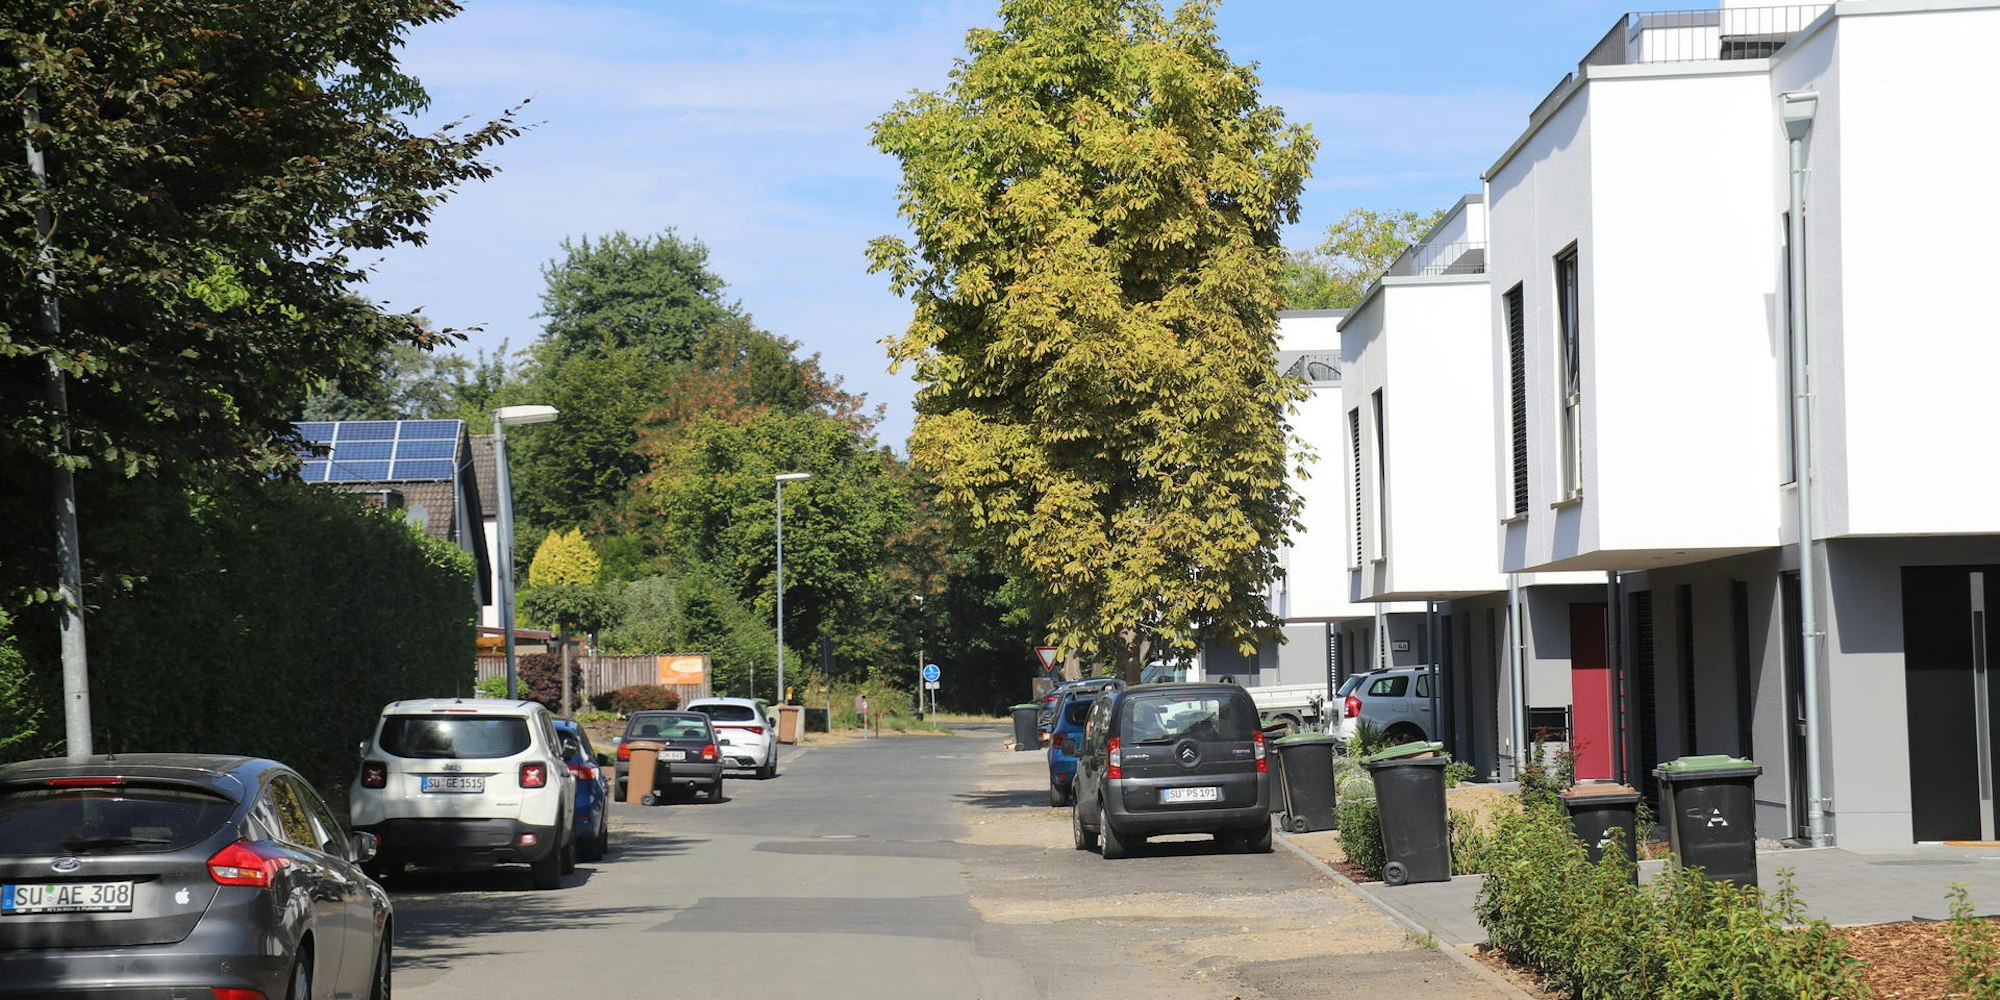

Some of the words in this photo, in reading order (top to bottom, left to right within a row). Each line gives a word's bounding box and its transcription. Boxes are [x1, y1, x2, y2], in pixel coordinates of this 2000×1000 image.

[428, 778, 440, 788] SU
[446, 778, 458, 788] GE
[461, 778, 482, 788] 1515
[1170, 790, 1182, 799] SU
[1186, 789, 1198, 798] PS
[1200, 788, 1216, 798] 191
[16, 887, 43, 906] SU
[57, 886, 84, 905] AE
[90, 884, 130, 904] 308
